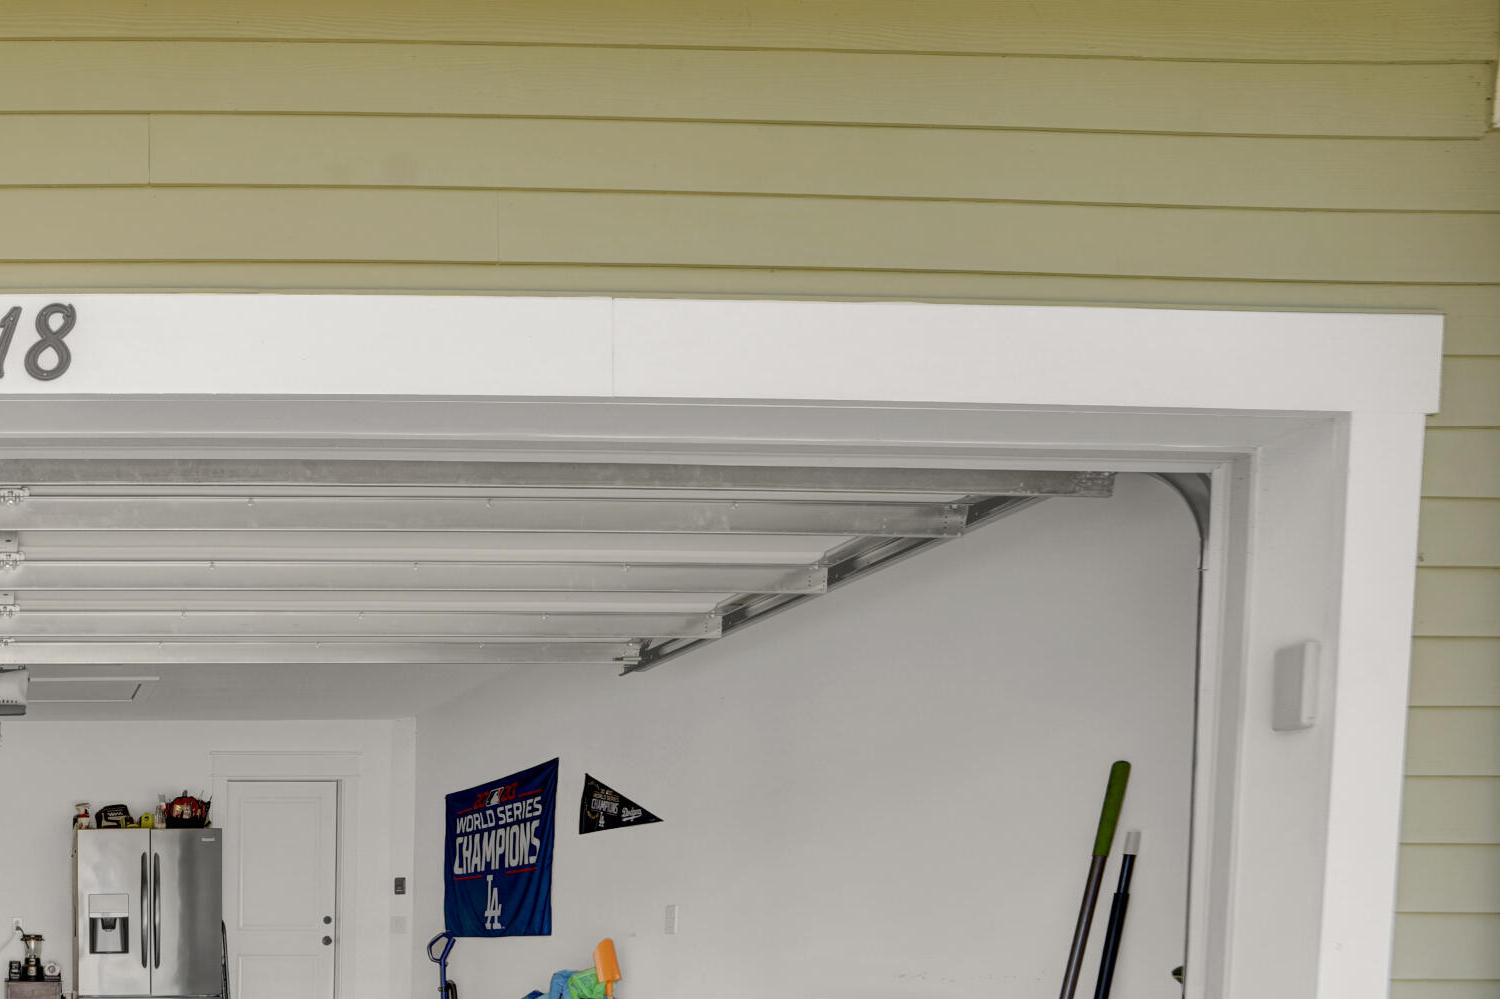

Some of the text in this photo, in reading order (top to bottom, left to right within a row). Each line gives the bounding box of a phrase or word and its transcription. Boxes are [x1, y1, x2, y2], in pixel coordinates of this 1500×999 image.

[456, 796, 542, 834] WORLD SERIES
[453, 819, 541, 875] CHAMPIONS
[484, 874, 502, 930] LA
